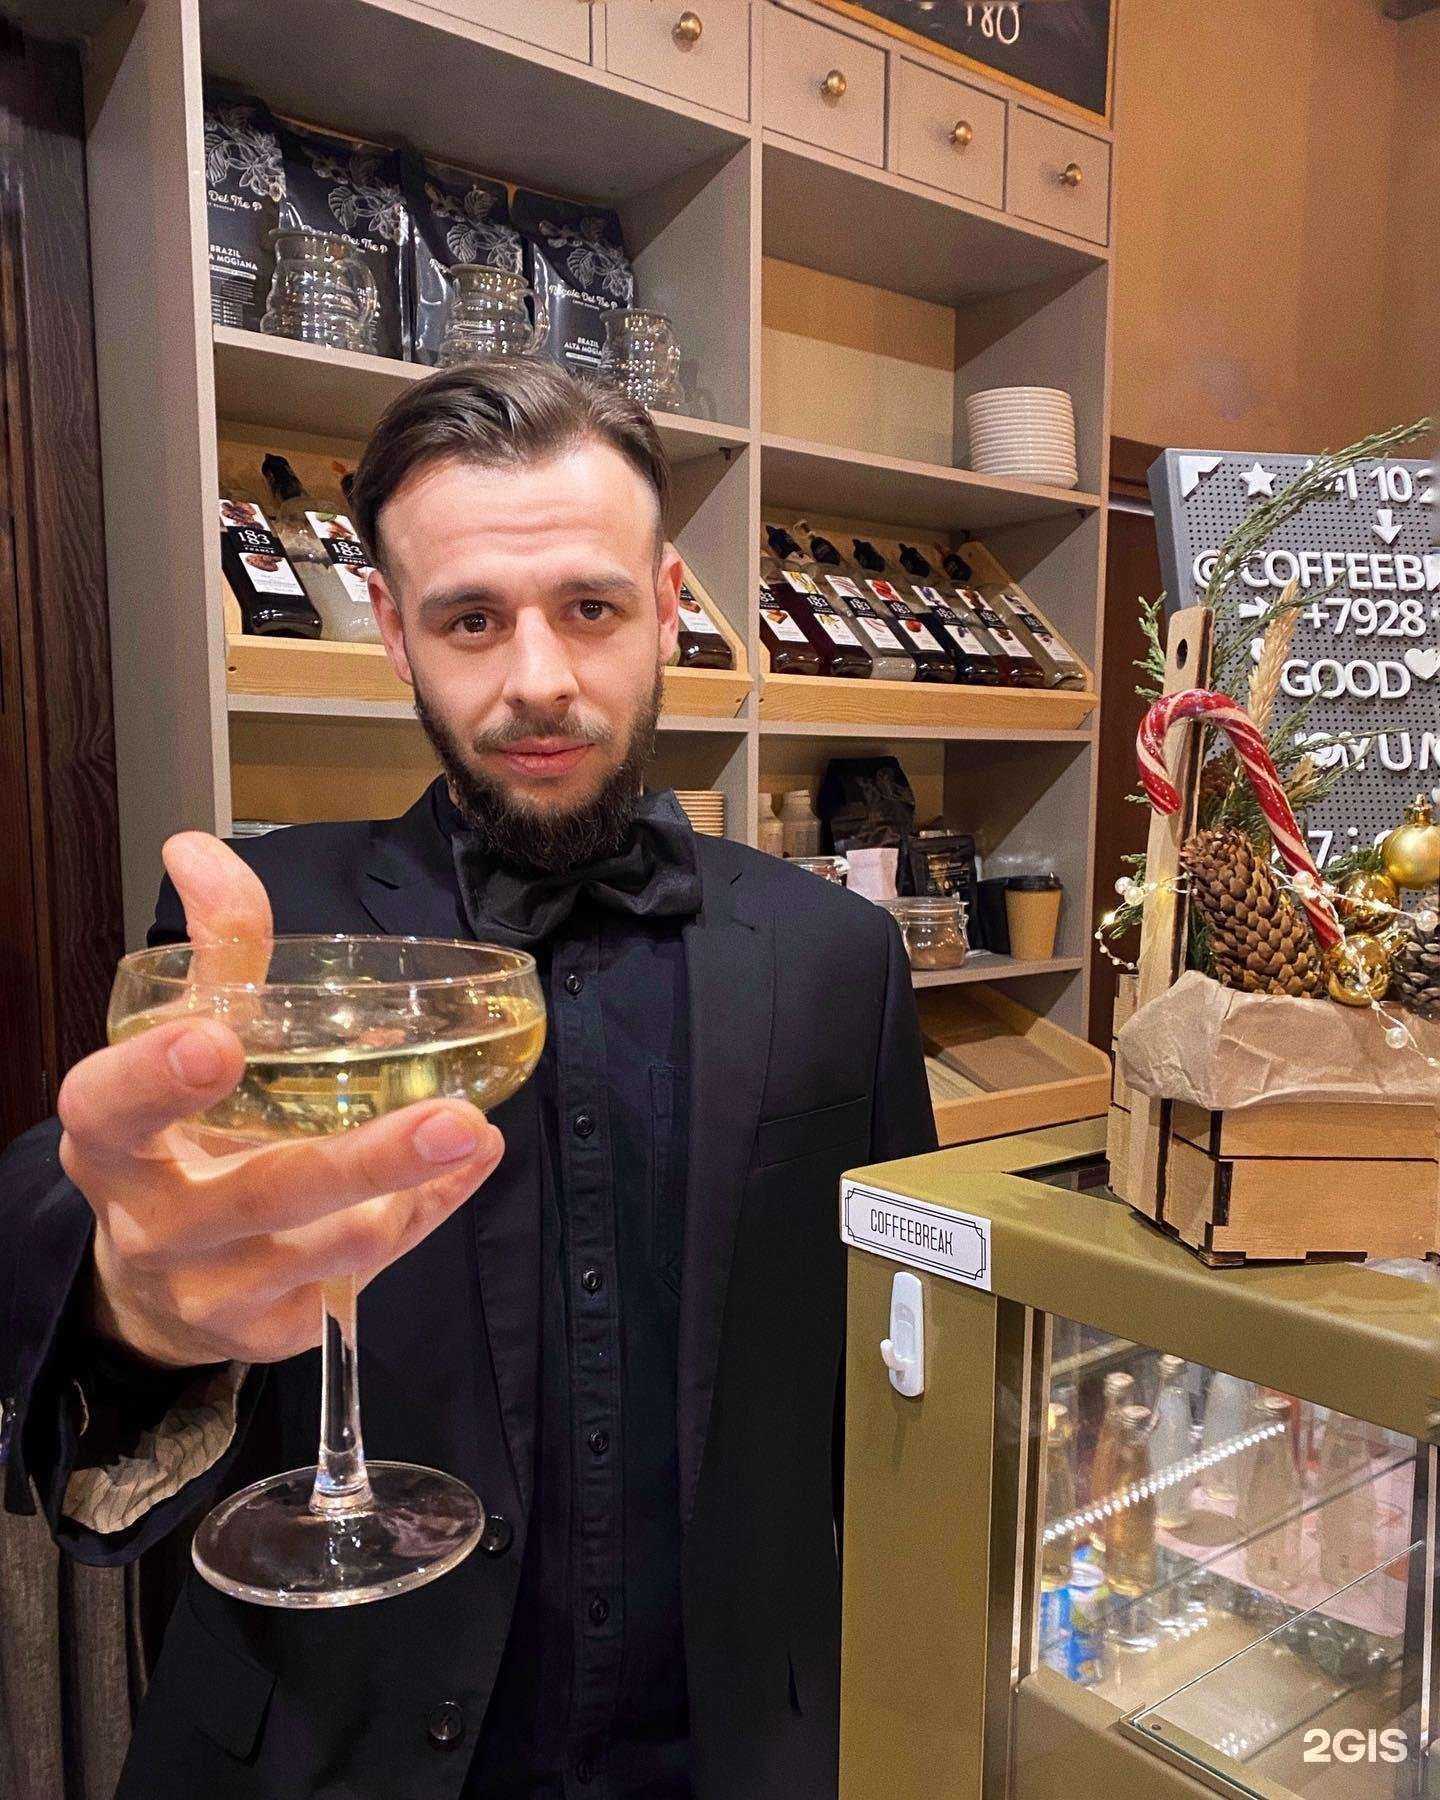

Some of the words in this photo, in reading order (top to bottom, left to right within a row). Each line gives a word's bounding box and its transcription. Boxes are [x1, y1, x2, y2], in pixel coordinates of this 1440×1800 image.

[210, 244, 242, 258] BRAZIL
[1280, 658, 1412, 699] GOOD
[870, 1208, 954, 1257] COFFEEBREAK
